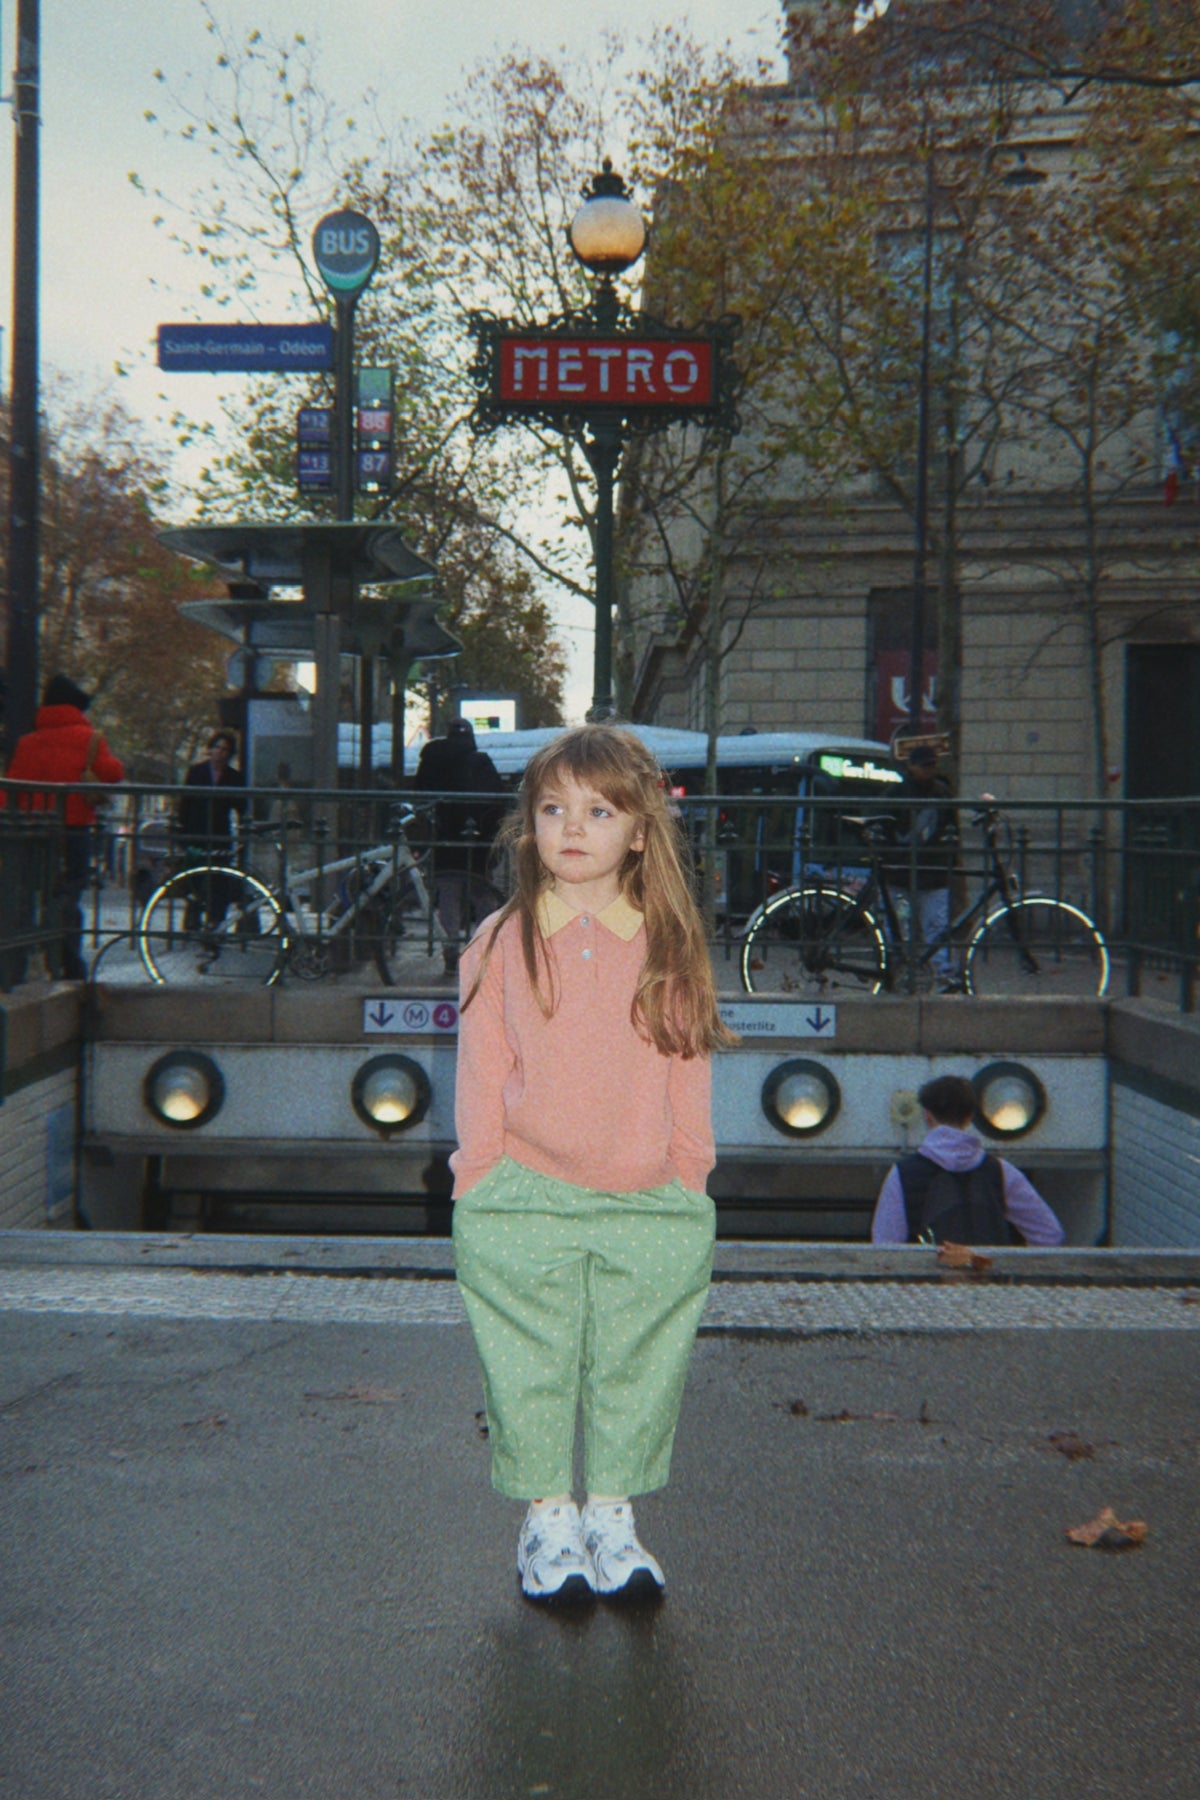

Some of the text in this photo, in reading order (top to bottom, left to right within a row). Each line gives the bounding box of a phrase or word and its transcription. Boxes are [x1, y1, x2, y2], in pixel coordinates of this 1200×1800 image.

[321, 229, 369, 254] BUS
[165, 340, 265, 355] Saint-Germain
[279, 340, 327, 355] Odéon
[513, 347, 699, 393] METRO
[362, 454, 387, 472] 87
[438, 1009, 450, 1024] 4
